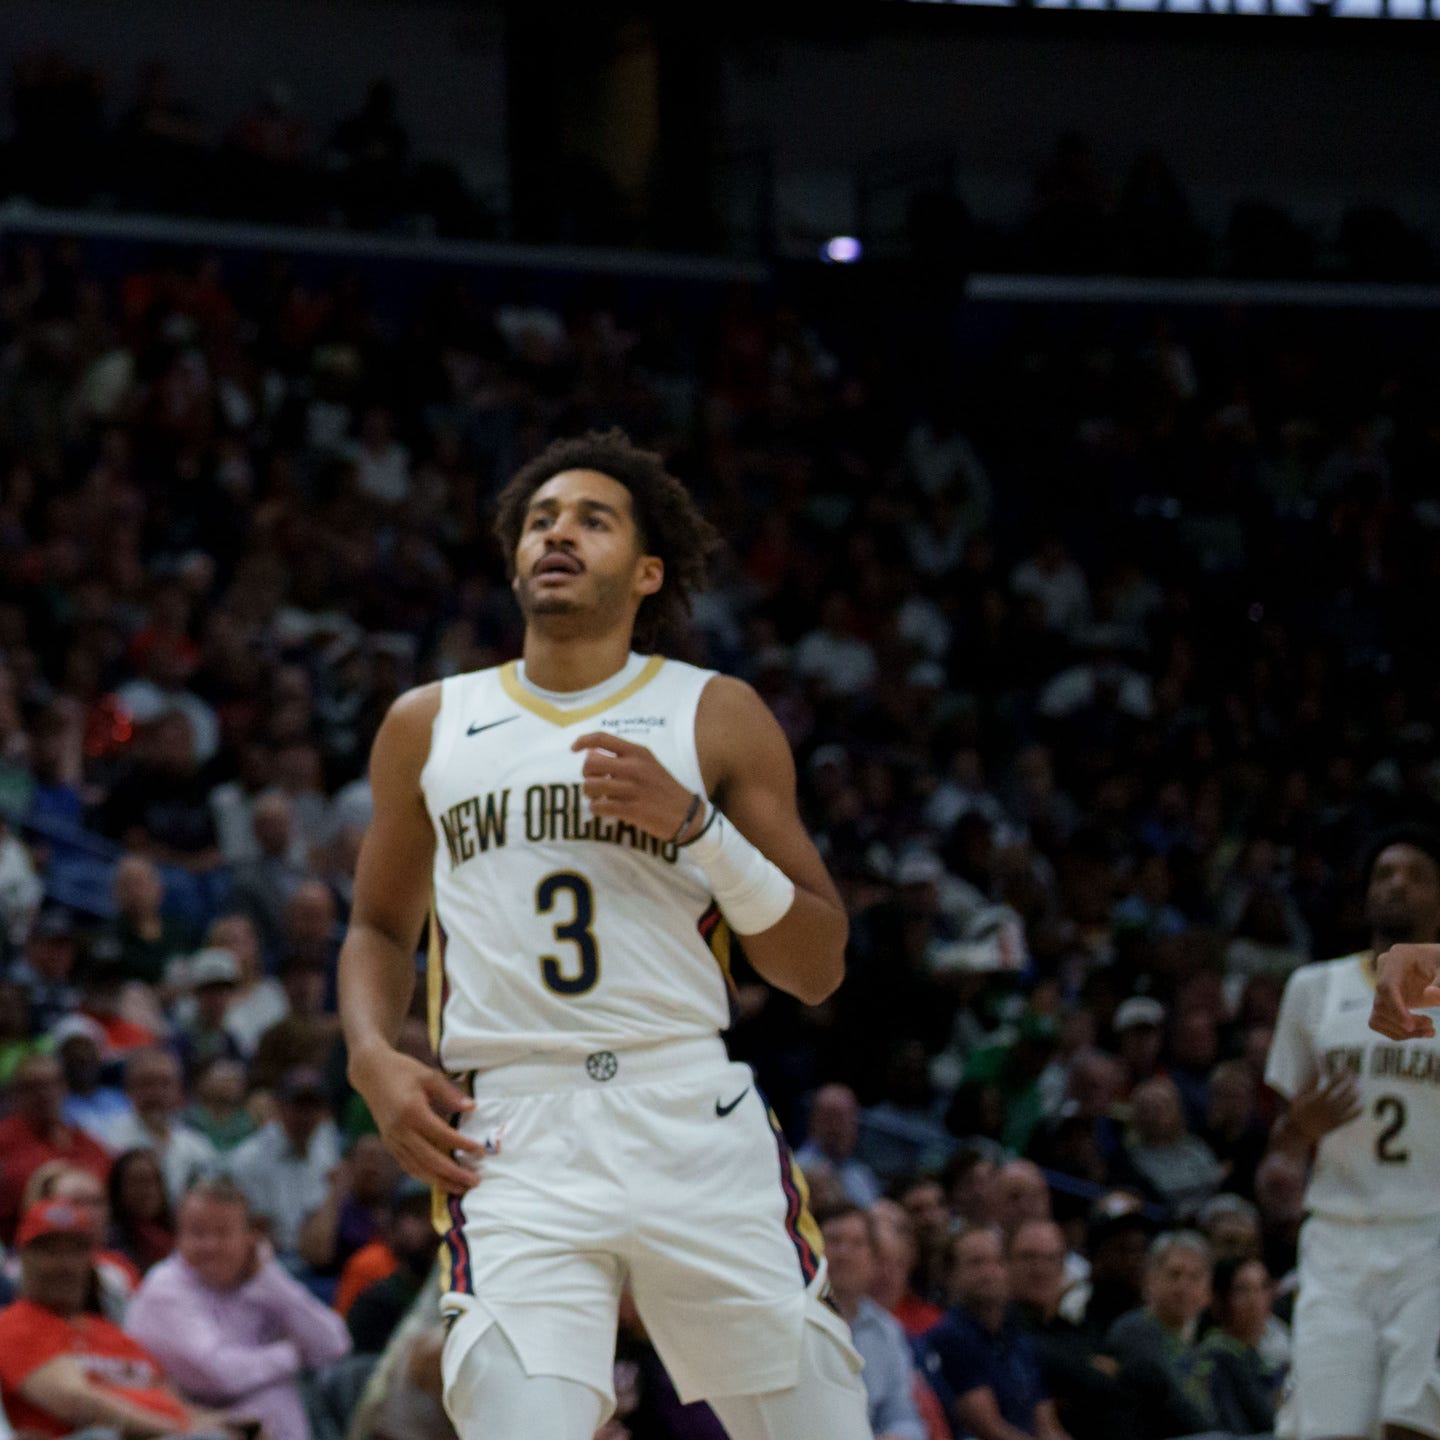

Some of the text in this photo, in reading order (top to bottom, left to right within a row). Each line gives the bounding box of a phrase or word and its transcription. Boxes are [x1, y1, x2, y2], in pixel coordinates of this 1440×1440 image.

[440, 788, 511, 872] NEW
[534, 868, 601, 999] 3
[1373, 1094, 1411, 1165] 2
